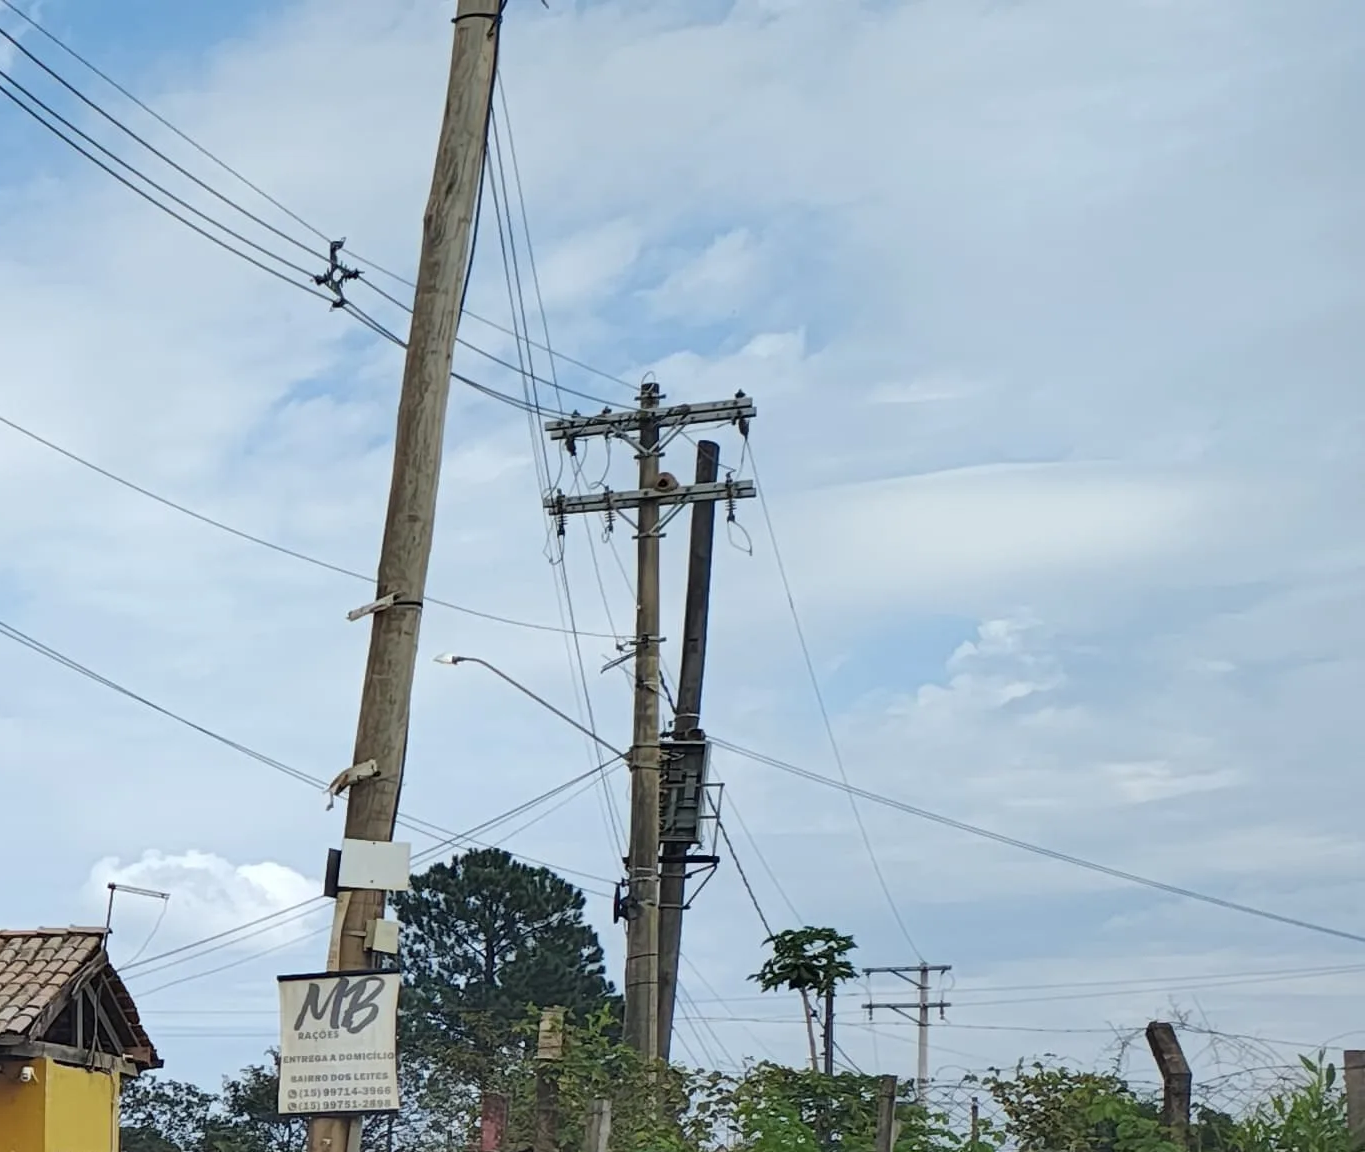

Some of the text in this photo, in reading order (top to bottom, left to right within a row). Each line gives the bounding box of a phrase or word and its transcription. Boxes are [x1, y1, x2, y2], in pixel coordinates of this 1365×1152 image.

[294, 976, 385, 1034] MB
[298, 1030, 340, 1041] RAÇÕES
[283, 1052, 395, 1064] ENTREGA A DOMICÍLIO
[291, 1072, 389, 1083] BAIRRO DOS LEITES
[299, 1088, 321, 1099] (15)
[299, 1101, 321, 1111] (15)
